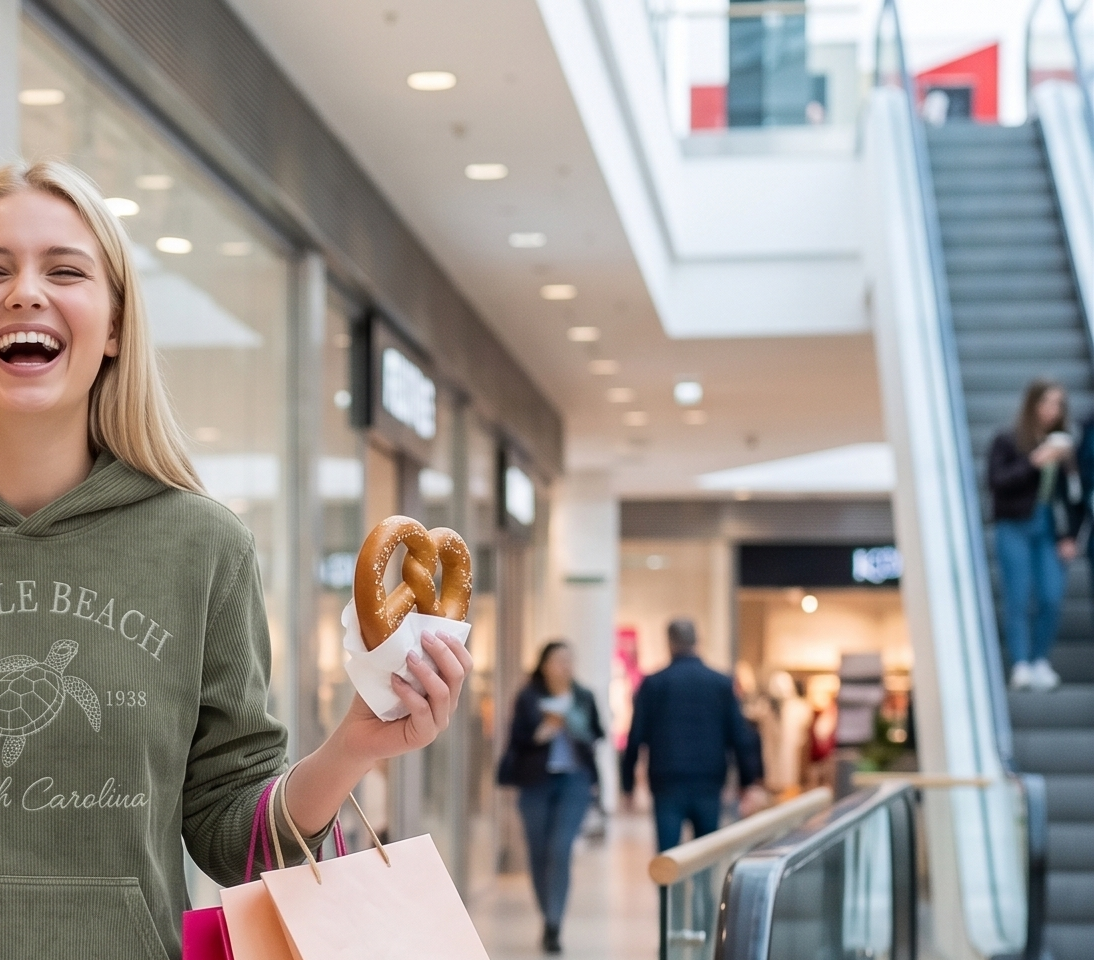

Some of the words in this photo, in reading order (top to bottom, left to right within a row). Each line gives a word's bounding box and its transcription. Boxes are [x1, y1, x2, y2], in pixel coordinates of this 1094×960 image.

[50, 581, 174, 661] BEACH
[106, 690, 147, 707] 1938
[21, 776, 149, 812] Carolina
